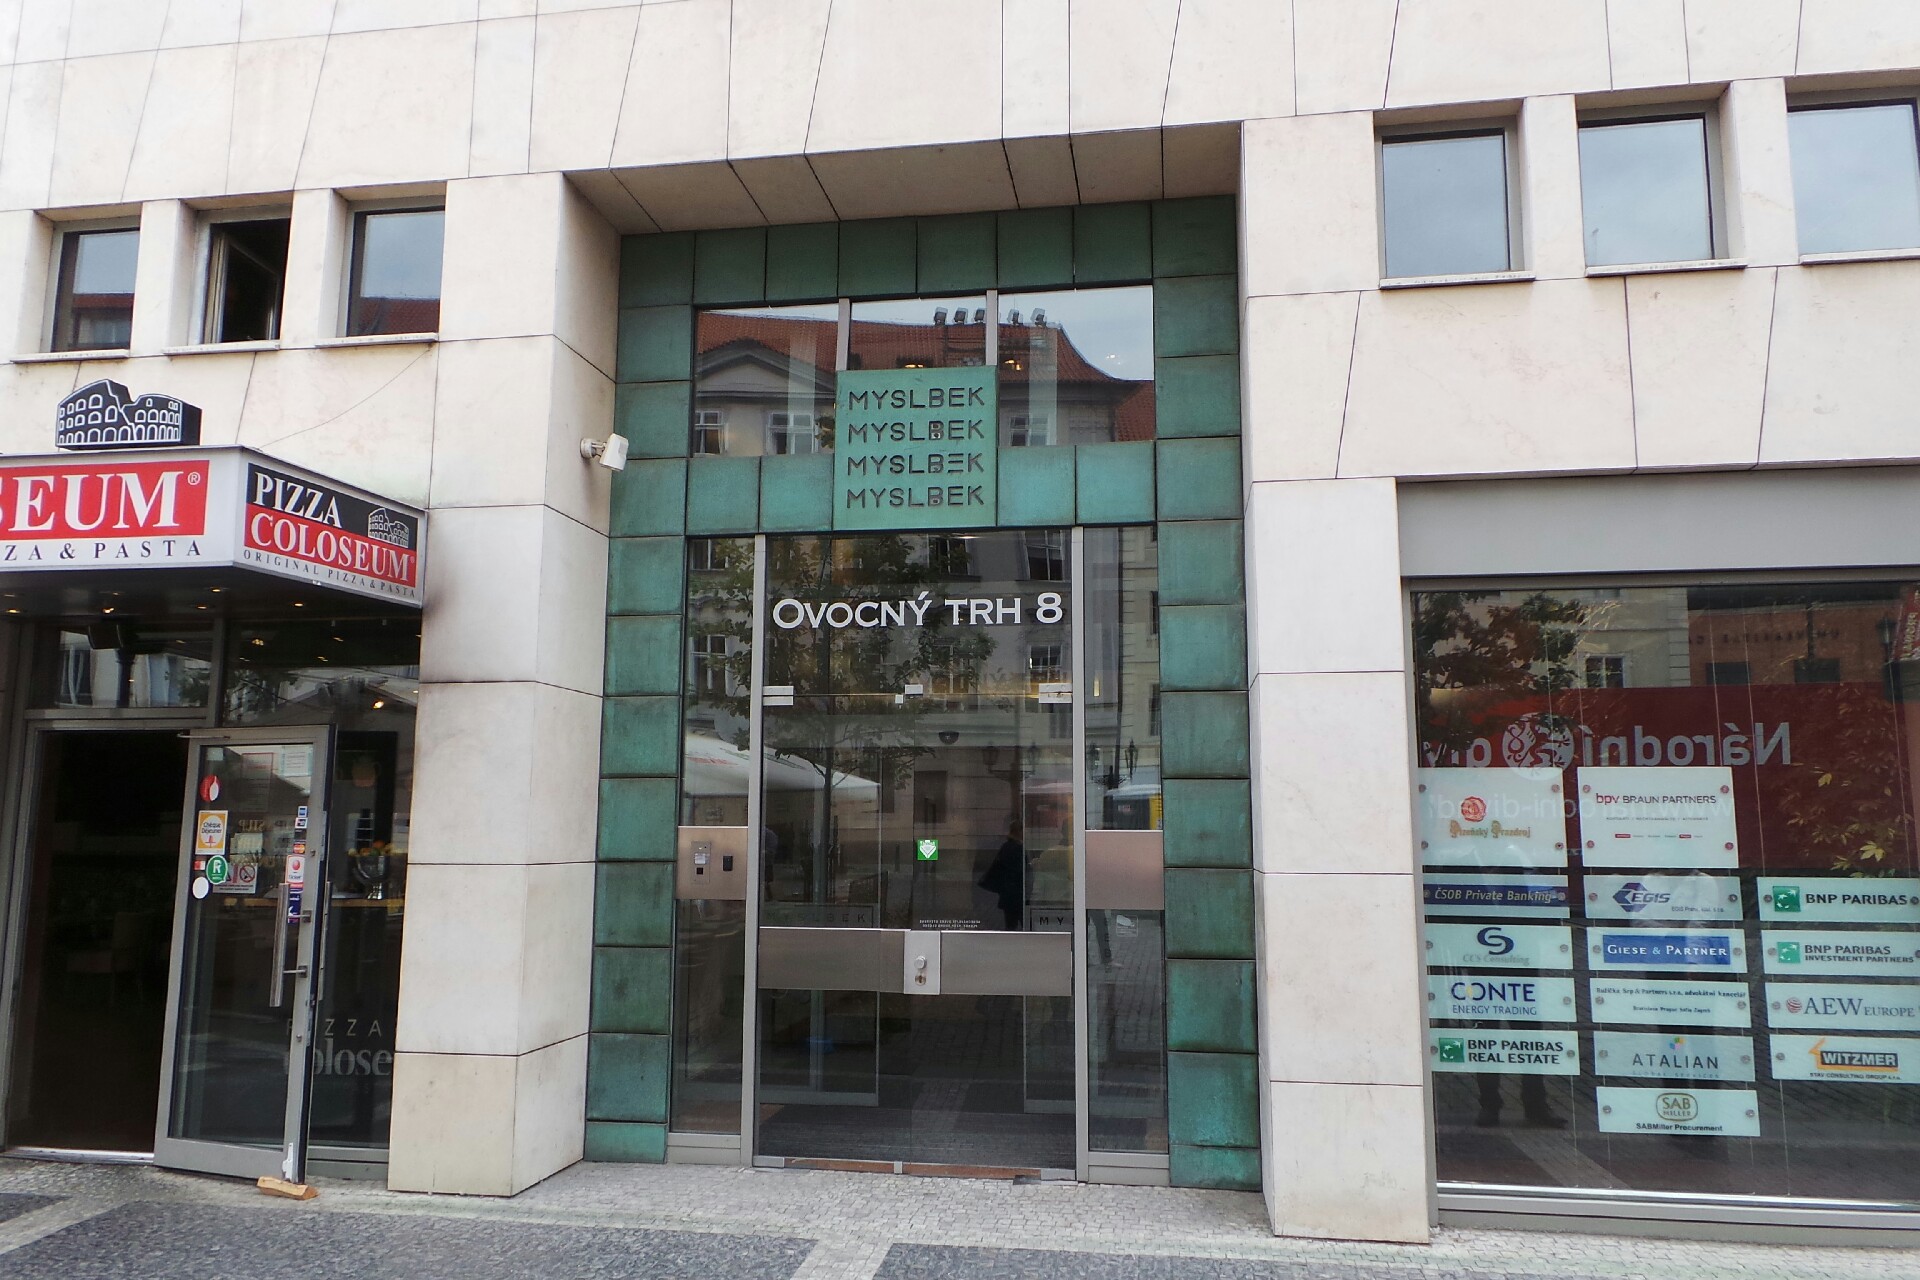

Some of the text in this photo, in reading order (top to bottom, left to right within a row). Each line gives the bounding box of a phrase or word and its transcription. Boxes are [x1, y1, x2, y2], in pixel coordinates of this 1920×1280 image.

[848, 386, 985, 411] MYSLBEK
[848, 419, 985, 444] MYSLBEK
[847, 452, 985, 476] MYSLBEK
[252, 471, 342, 528] PIZZA
[846, 485, 985, 509] MYSLBEK
[59, 543, 76, 560] &
[94, 540, 201, 559] PASTA
[243, 549, 415, 598] ORIGINAL PIZZA & PASTA
[944, 597, 1022, 626] TRH
[1035, 592, 1064, 624] 8
[1596, 793, 1717, 806] bpv BRAUN PARTNERS
[1434, 887, 1551, 903] ČSOB Private Banking
[1631, 892, 1671, 904] EGIS
[1805, 893, 1908, 905] BNP PARIBAS
[1652, 946, 1661, 955] &
[1804, 944, 1891, 955] BNP PARIBAS
[1451, 982, 1536, 1002] CONTE
[1452, 1004, 1537, 1016] ENERGY TRADING
[1803, 998, 1915, 1017] AEW EUROPE
[1467, 1039, 1564, 1052] BNP PARIBAS
[1468, 1052, 1560, 1065] REAL ESTATE
[1632, 1053, 1719, 1069] ATALIAN
[1822, 1051, 1897, 1067] WITZMER
[1662, 1097, 1691, 1110] SAB
[1674, 1123, 1723, 1132] Procurement
